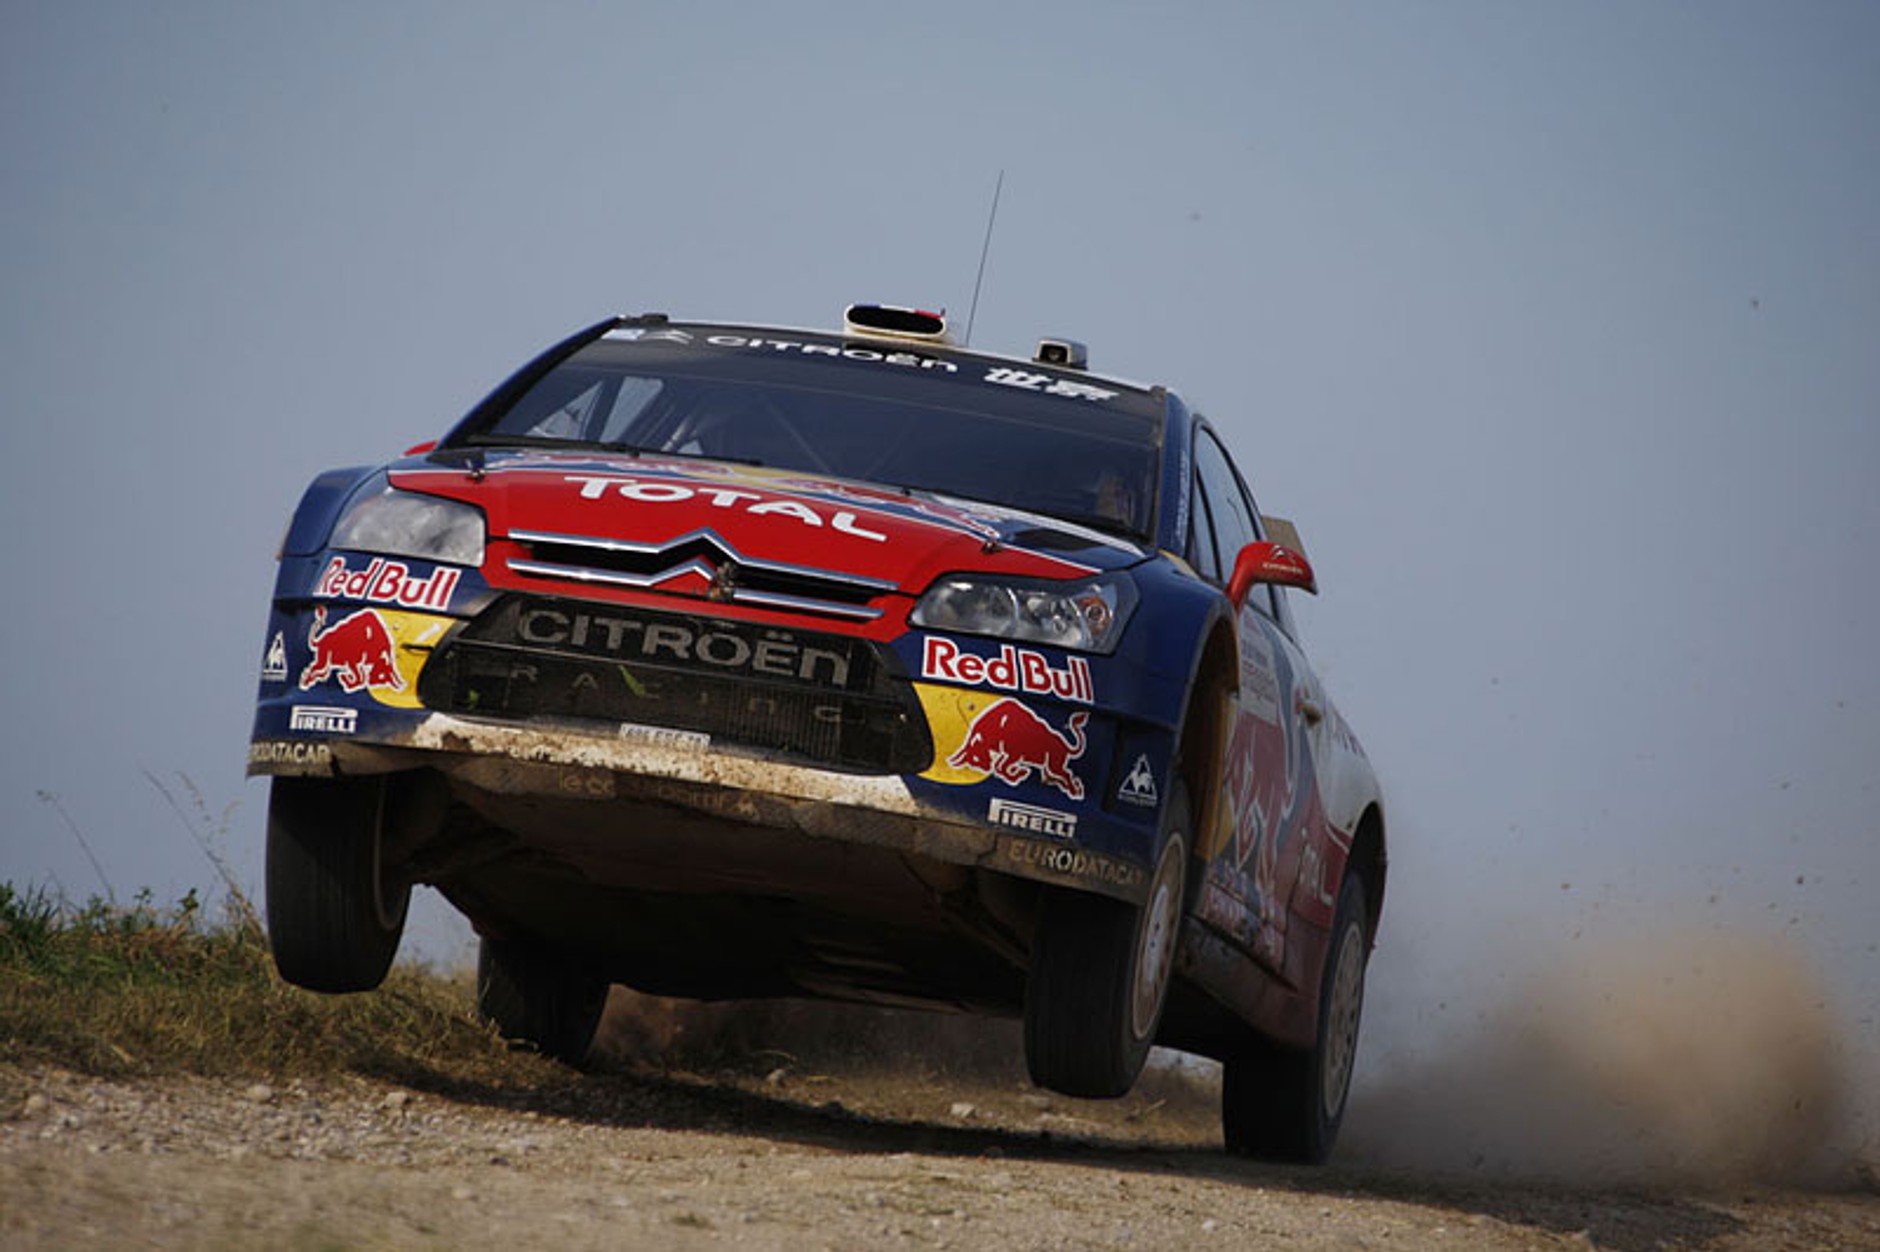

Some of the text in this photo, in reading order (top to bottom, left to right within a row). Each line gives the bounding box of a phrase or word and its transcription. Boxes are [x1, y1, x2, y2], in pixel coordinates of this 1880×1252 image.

[564, 476, 887, 542] TOTAL
[314, 556, 461, 611] Red Bull
[922, 635, 1094, 703] Red Bull
[290, 705, 358, 733] PIRELLI
[987, 797, 1078, 838] PIRELLI
